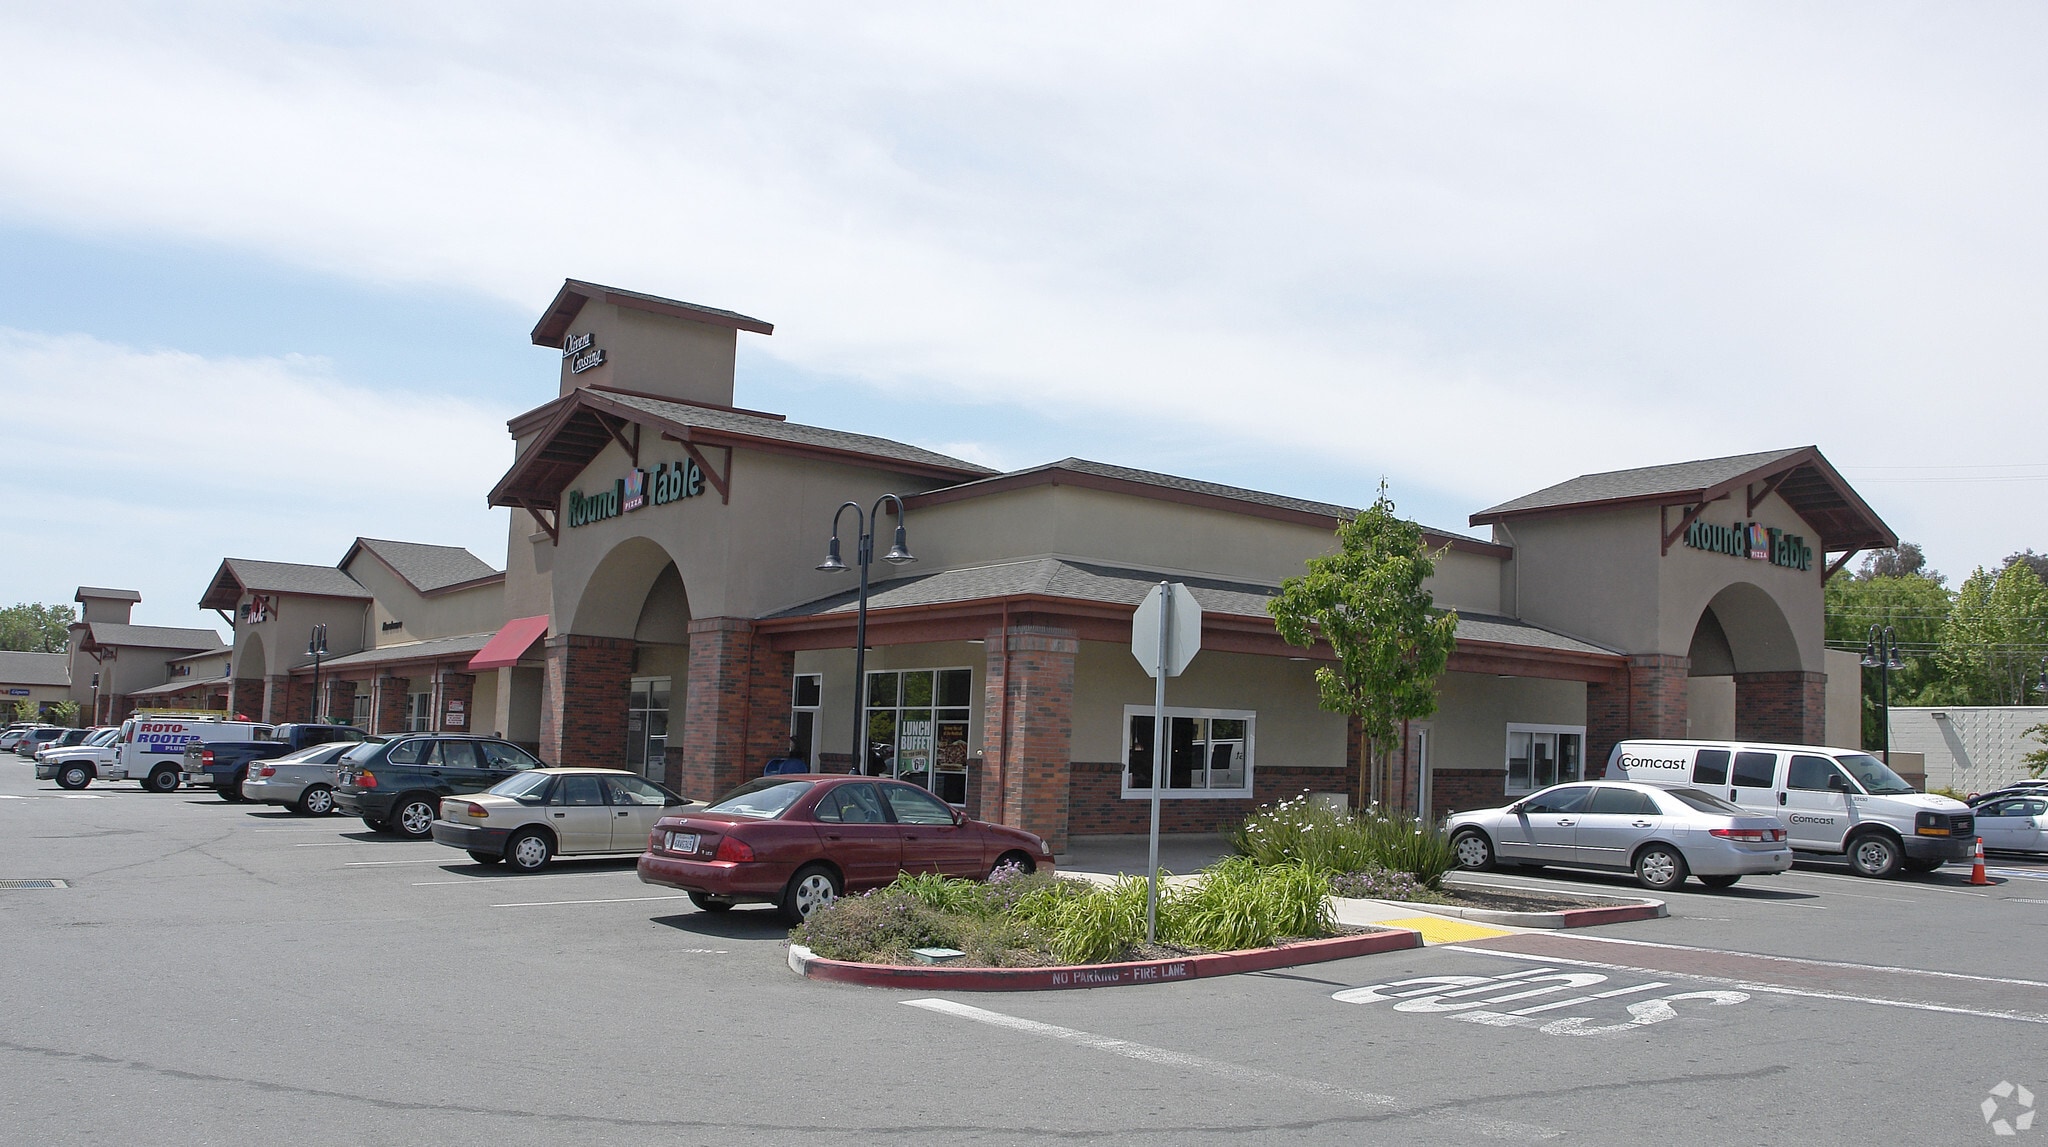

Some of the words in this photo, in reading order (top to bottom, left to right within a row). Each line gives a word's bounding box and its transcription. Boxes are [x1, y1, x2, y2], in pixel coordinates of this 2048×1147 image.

[571, 350, 602, 374] Crossing
[568, 479, 623, 527] Round
[649, 458, 701, 506] Table
[625, 498, 642, 510] PIZZA
[1689, 518, 1744, 557] Round
[1772, 527, 1812, 571] Table
[1751, 550, 1767, 559] PIZZA
[140, 724, 189, 733] ROTO-
[902, 721, 931, 736] LUNCH
[900, 736, 931, 750] BUFFET
[1052, 972, 1068, 985] NO
[1073, 970, 1119, 984] PARKING
[1133, 966, 1158, 980] FIRE
[1161, 963, 1187, 978] LANE
[1331, 967, 1751, 1036] STOP
